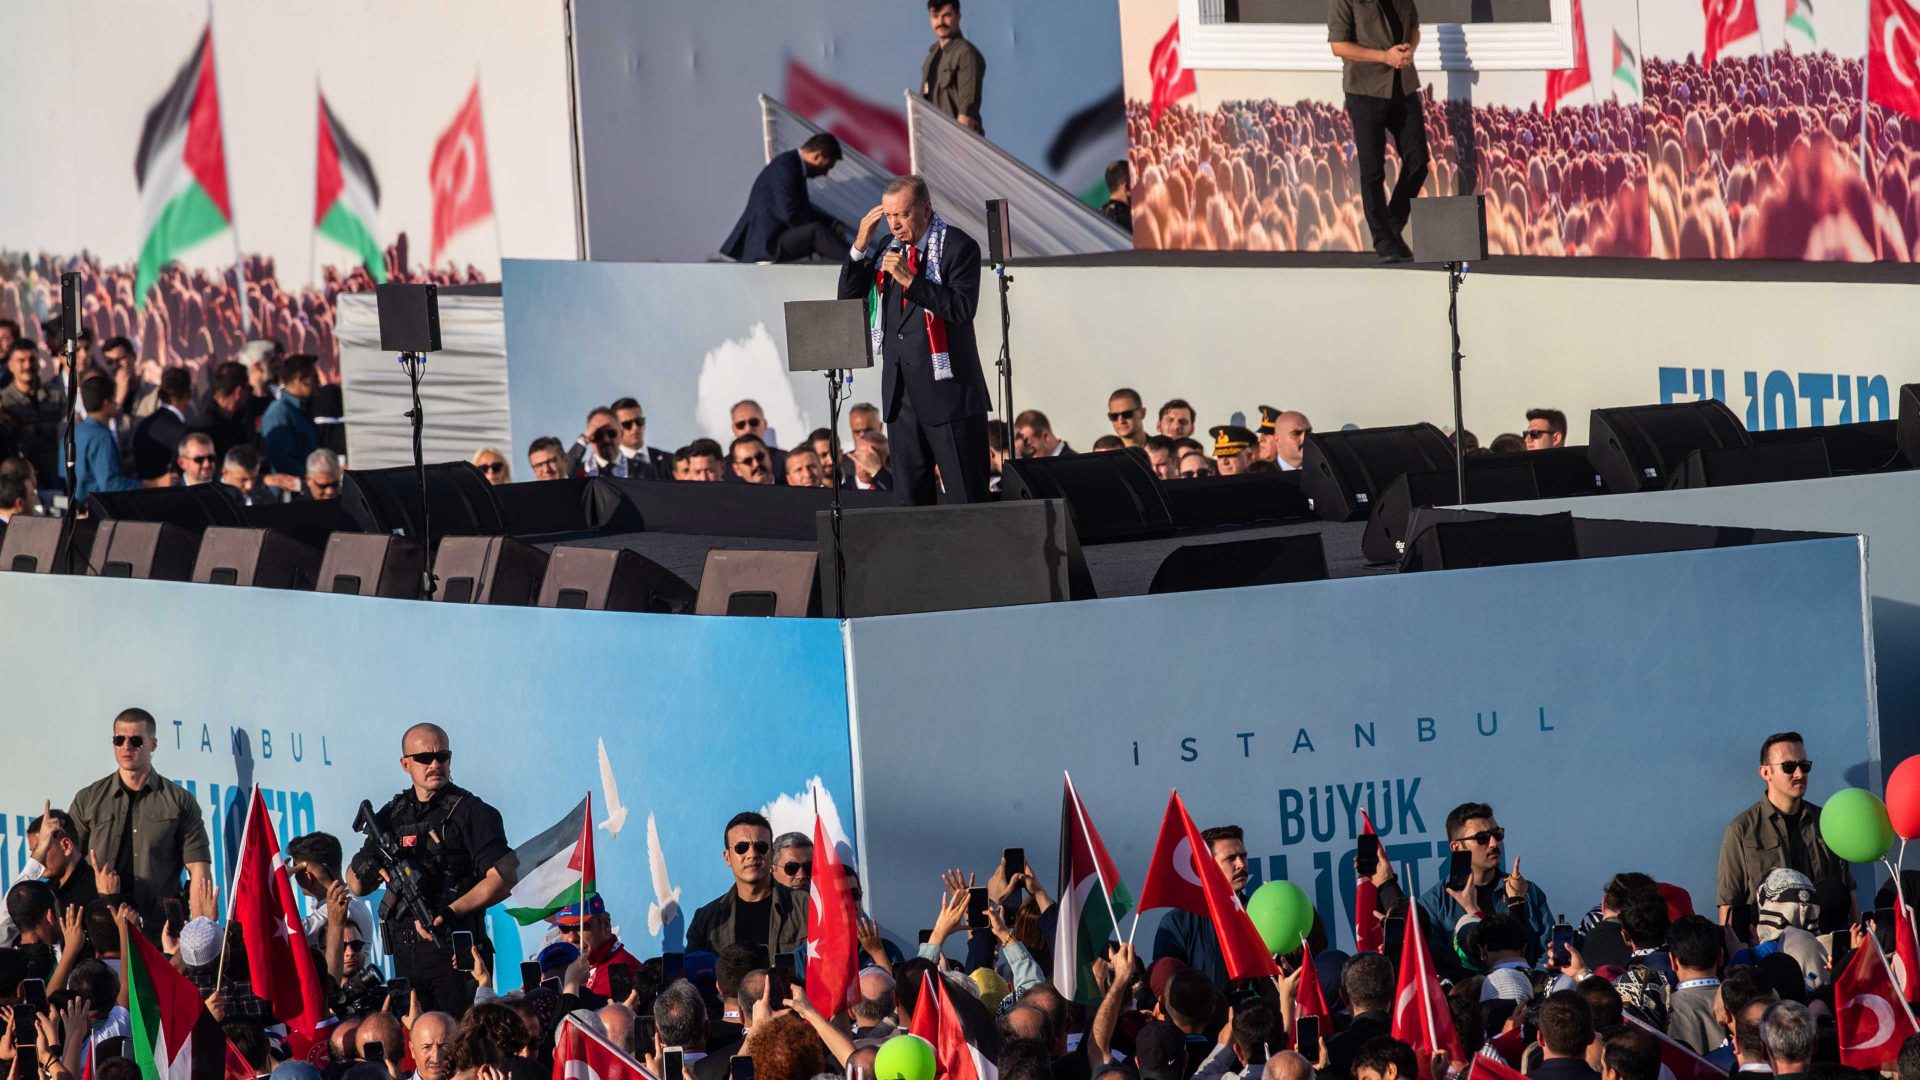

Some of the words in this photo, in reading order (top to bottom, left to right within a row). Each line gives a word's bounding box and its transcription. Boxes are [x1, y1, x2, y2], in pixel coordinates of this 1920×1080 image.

[173, 719, 333, 767] TANBUL
[1132, 707, 1555, 766] İSTANBUL
[1279, 777, 1427, 846] BÜYÜK
